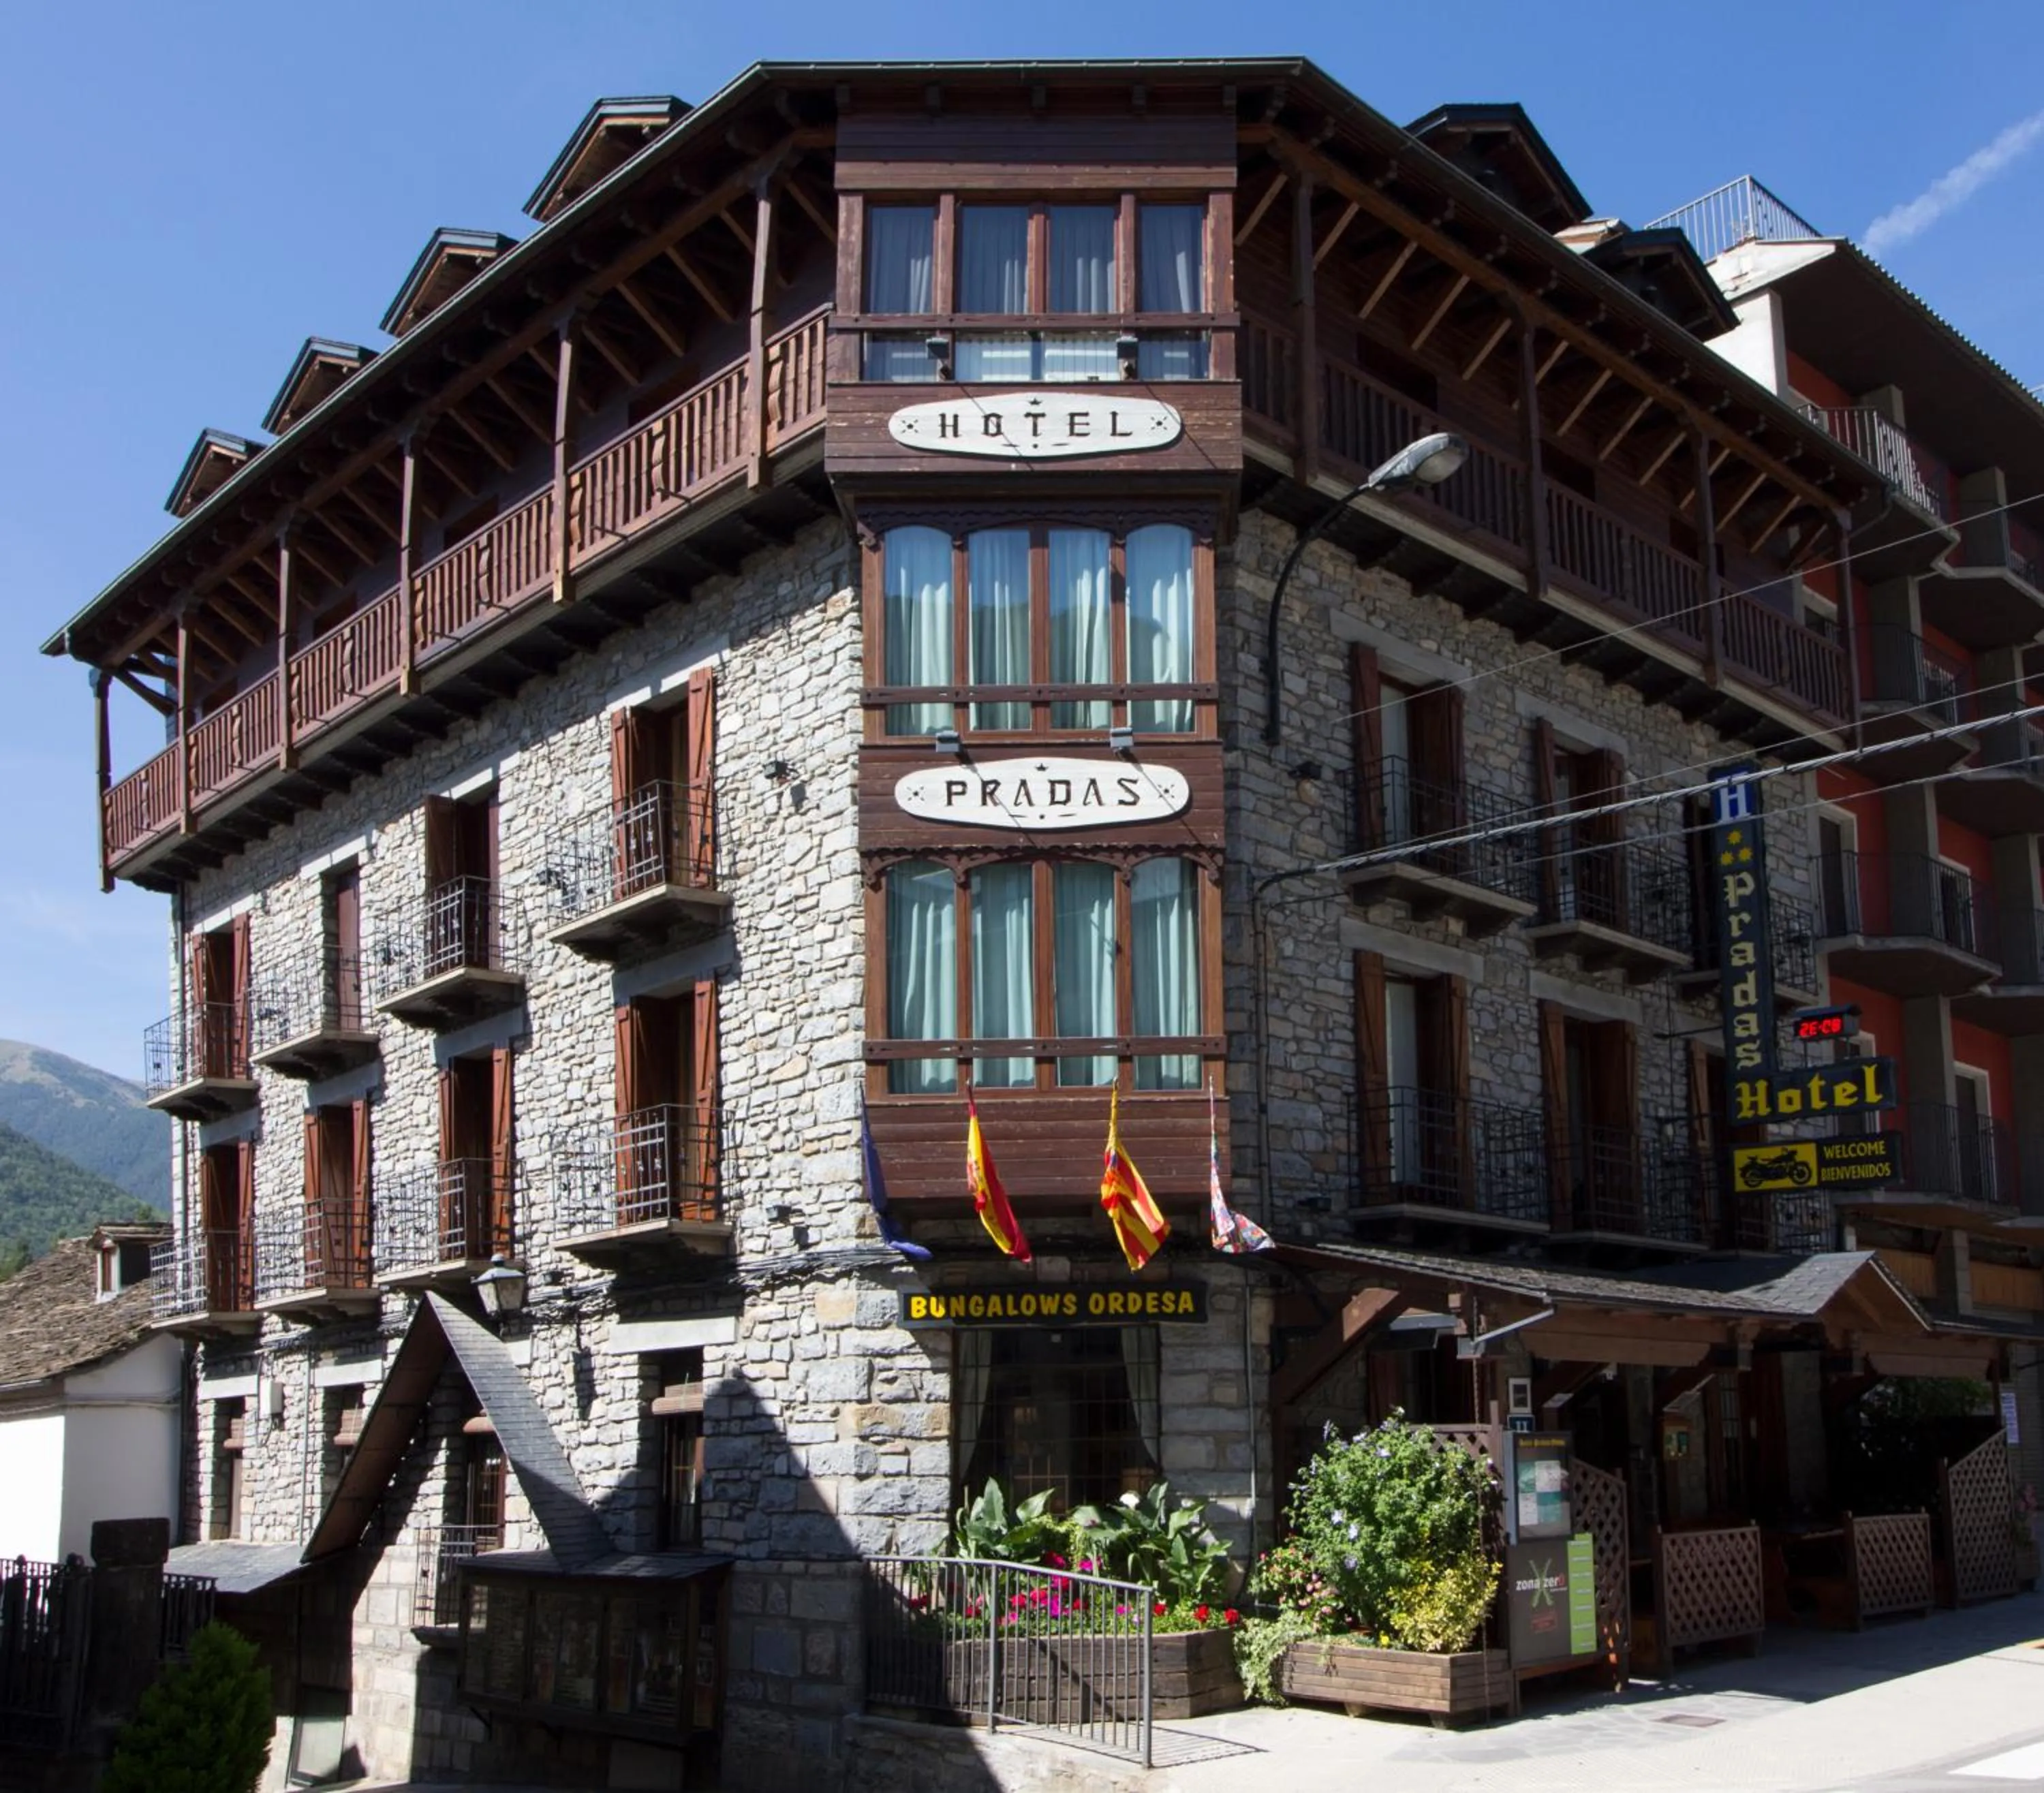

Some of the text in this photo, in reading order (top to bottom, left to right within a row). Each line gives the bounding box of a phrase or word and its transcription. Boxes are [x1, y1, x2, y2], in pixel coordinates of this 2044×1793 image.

[938, 411, 1132, 438] HOTEL
[945, 777, 1141, 807] PRADAS
[1715, 771, 1752, 824] H
[1735, 1063, 1883, 1119] Hotel
[1823, 1140, 1887, 1160] WELCOME
[1821, 1162, 1892, 1182] BIENVENIDOS
[910, 1291, 1194, 1320] BUNGALOWS ORDESA
